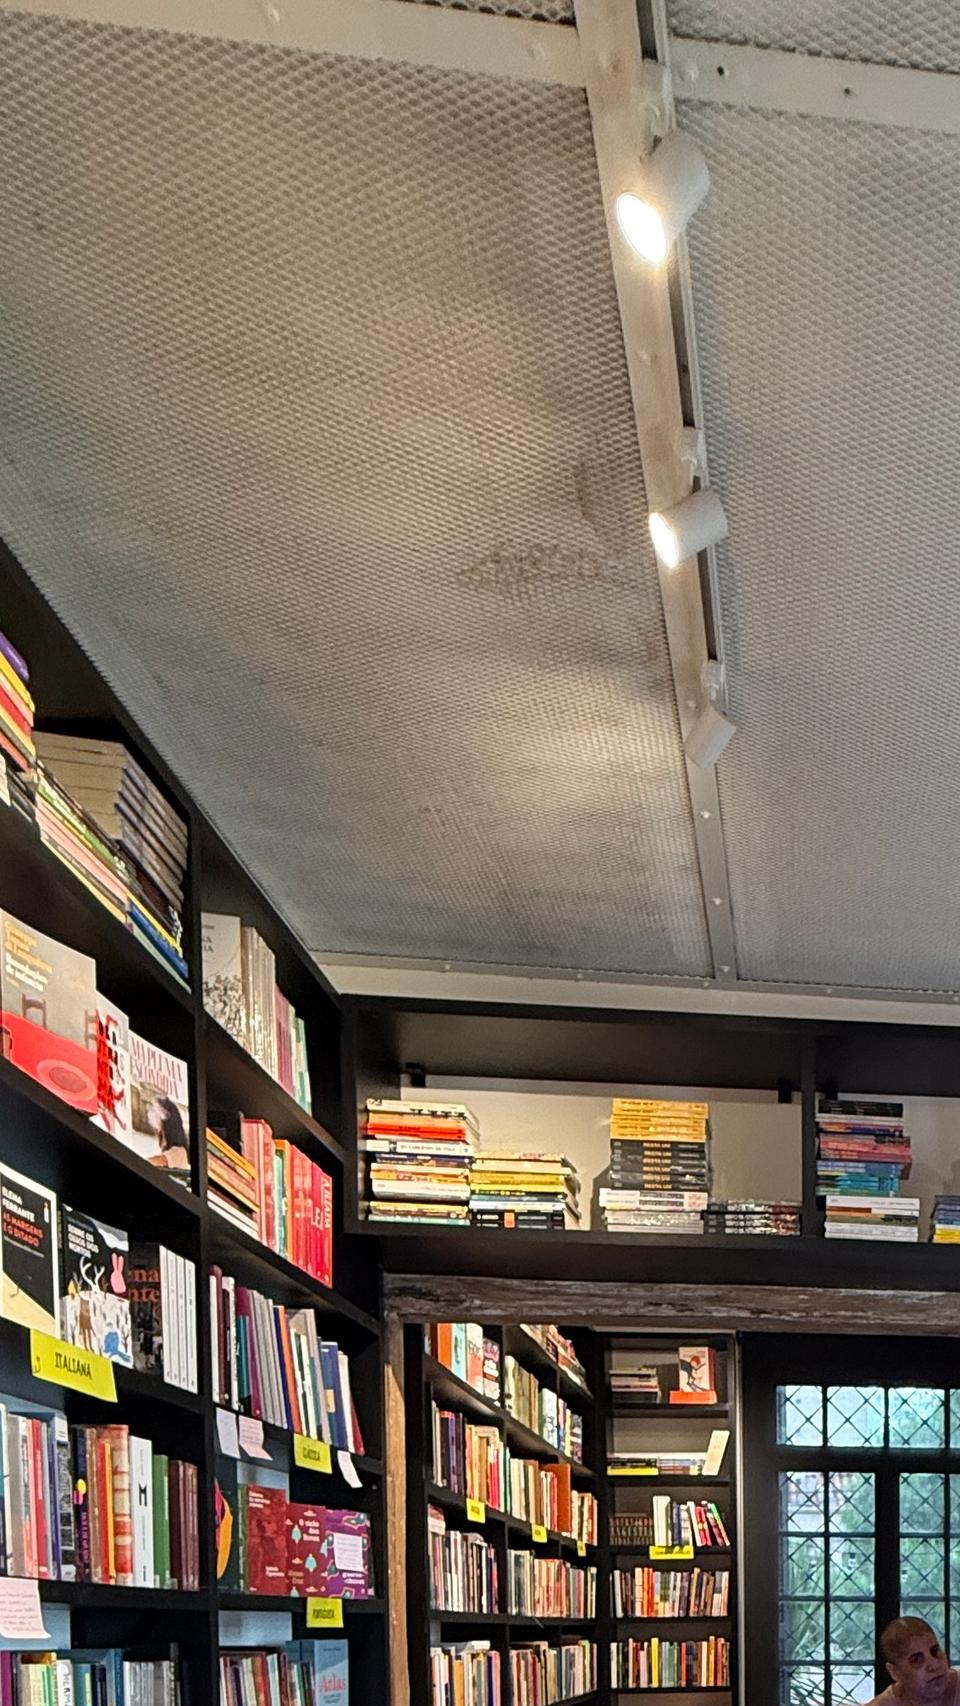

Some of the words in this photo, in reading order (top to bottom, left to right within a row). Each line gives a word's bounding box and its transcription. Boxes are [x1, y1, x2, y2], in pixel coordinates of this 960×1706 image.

[2, 1186, 23, 1205] ELENA
[2, 1198, 36, 1223] FERRANTE
[55, 1352, 93, 1379] ITALIANA
